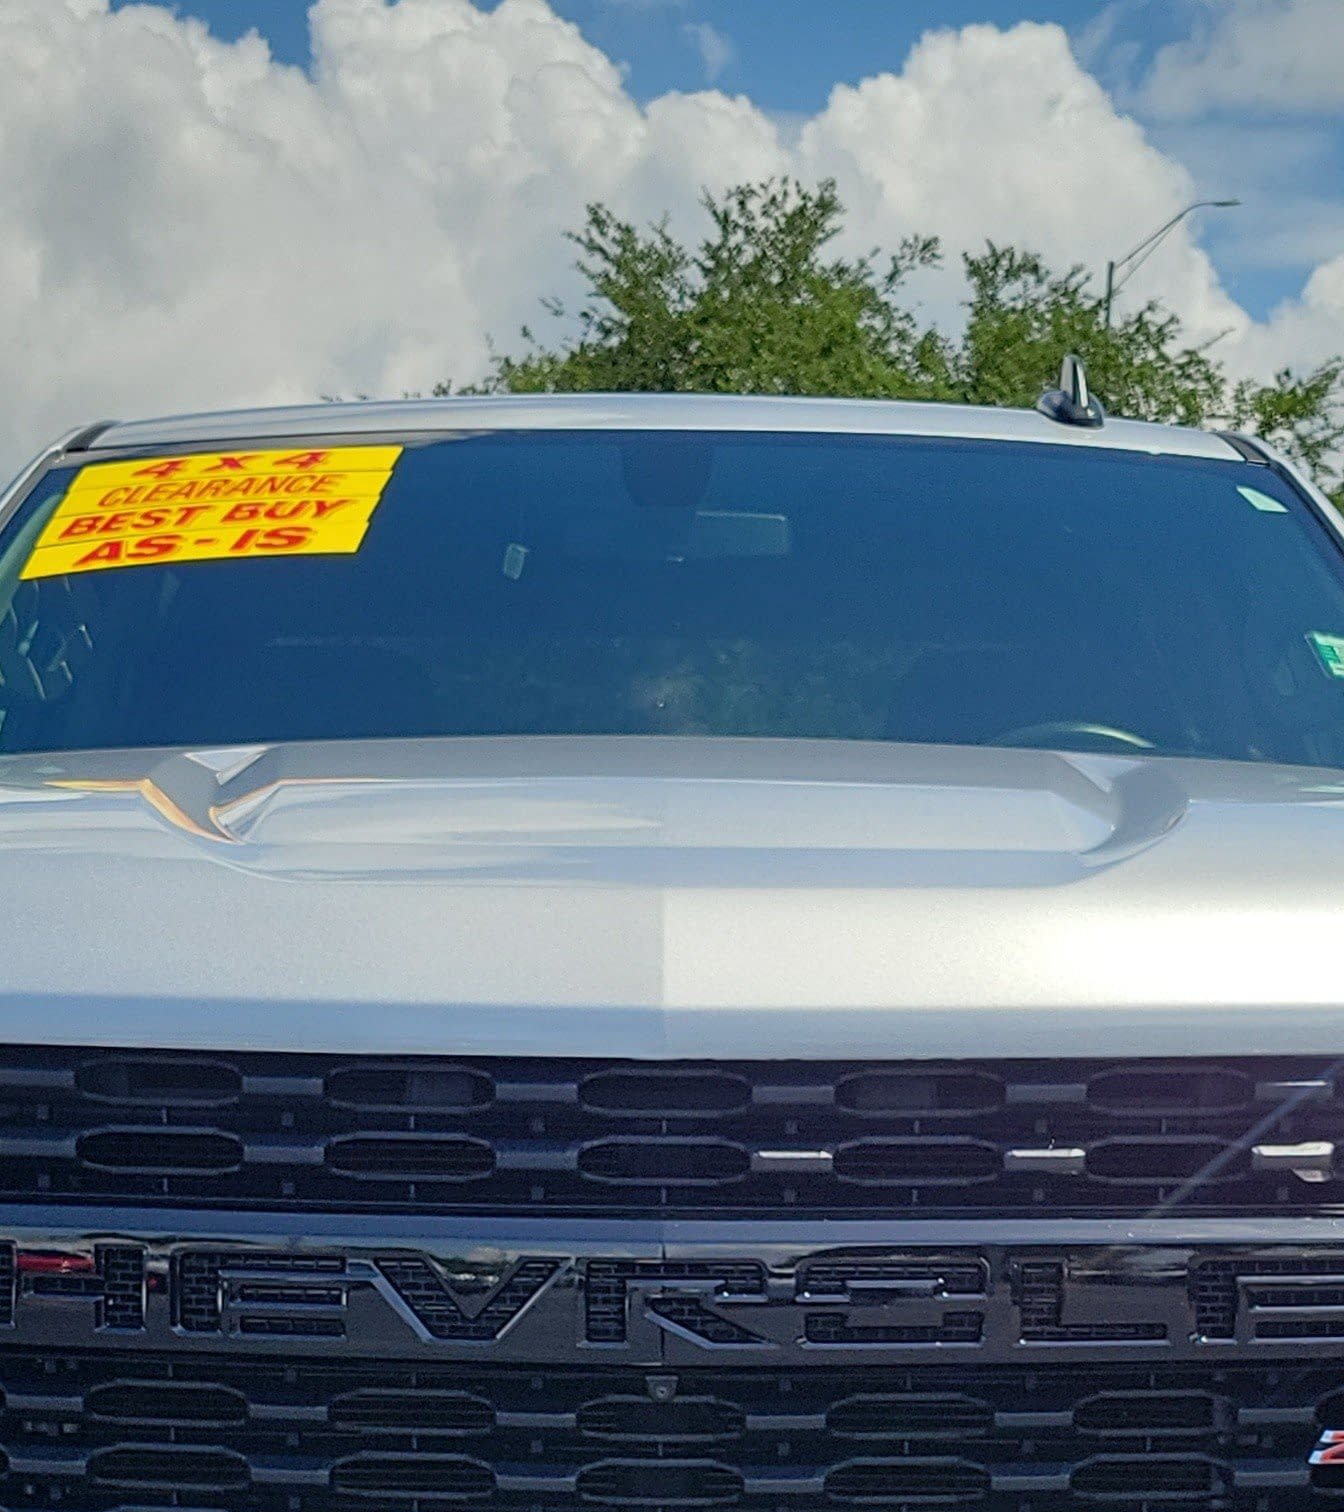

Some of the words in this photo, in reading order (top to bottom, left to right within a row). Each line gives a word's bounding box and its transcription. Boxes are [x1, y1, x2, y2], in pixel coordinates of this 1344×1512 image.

[98, 472, 347, 508] CLEARANCE
[58, 504, 211, 541] BEST
[221, 498, 350, 525] BUY
